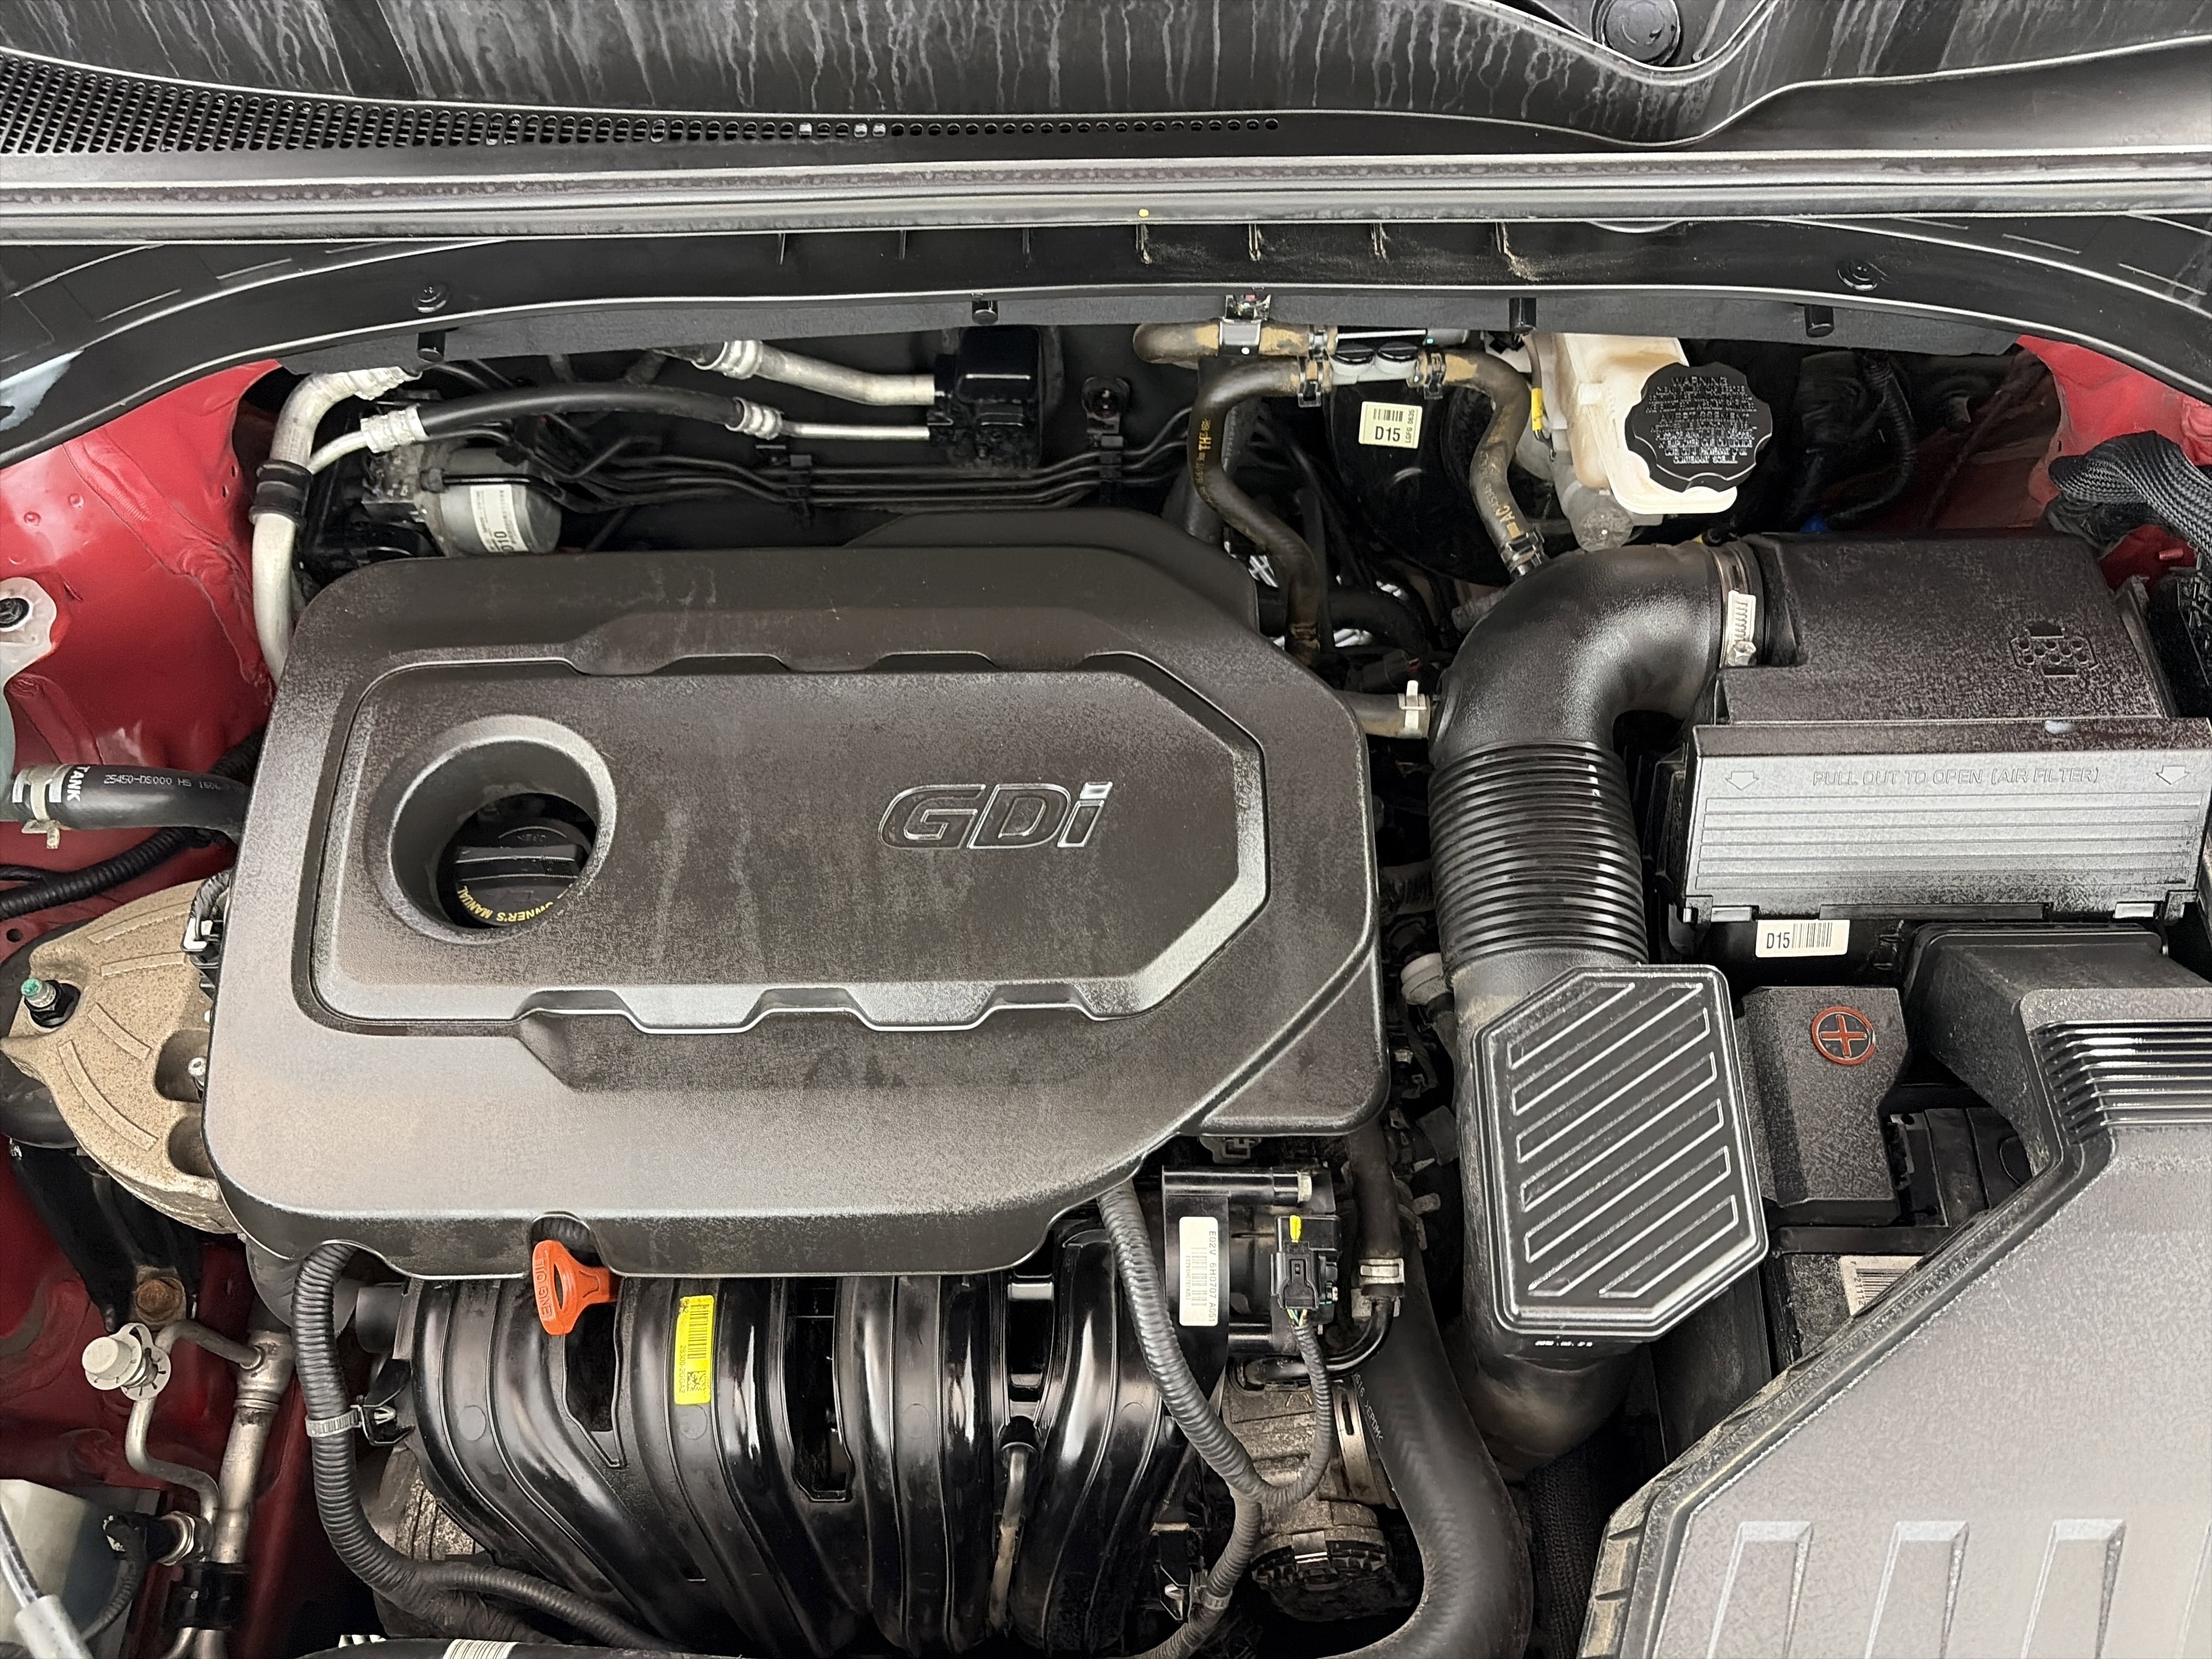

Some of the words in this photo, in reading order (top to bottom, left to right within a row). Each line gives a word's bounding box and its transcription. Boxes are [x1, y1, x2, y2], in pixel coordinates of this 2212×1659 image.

[1375, 426, 1401, 442] D15
[66, 766, 91, 802] TANK
[1813, 770, 1858, 786] PULL
[1863, 770, 1900, 785] OUT
[1905, 770, 1927, 785] TO
[1932, 769, 1983, 785] OPEN
[1990, 768, 2029, 785] (AIR
[2033, 767, 2100, 784] FILTER)
[878, 781, 1113, 850] GDi
[457, 885, 494, 919] MANUAL
[1767, 932, 1790, 949] D15
[534, 1258, 547, 1283] OIL
[1209, 1263, 1217, 1299] 6H0707
[538, 1286, 552, 1318] ENG
